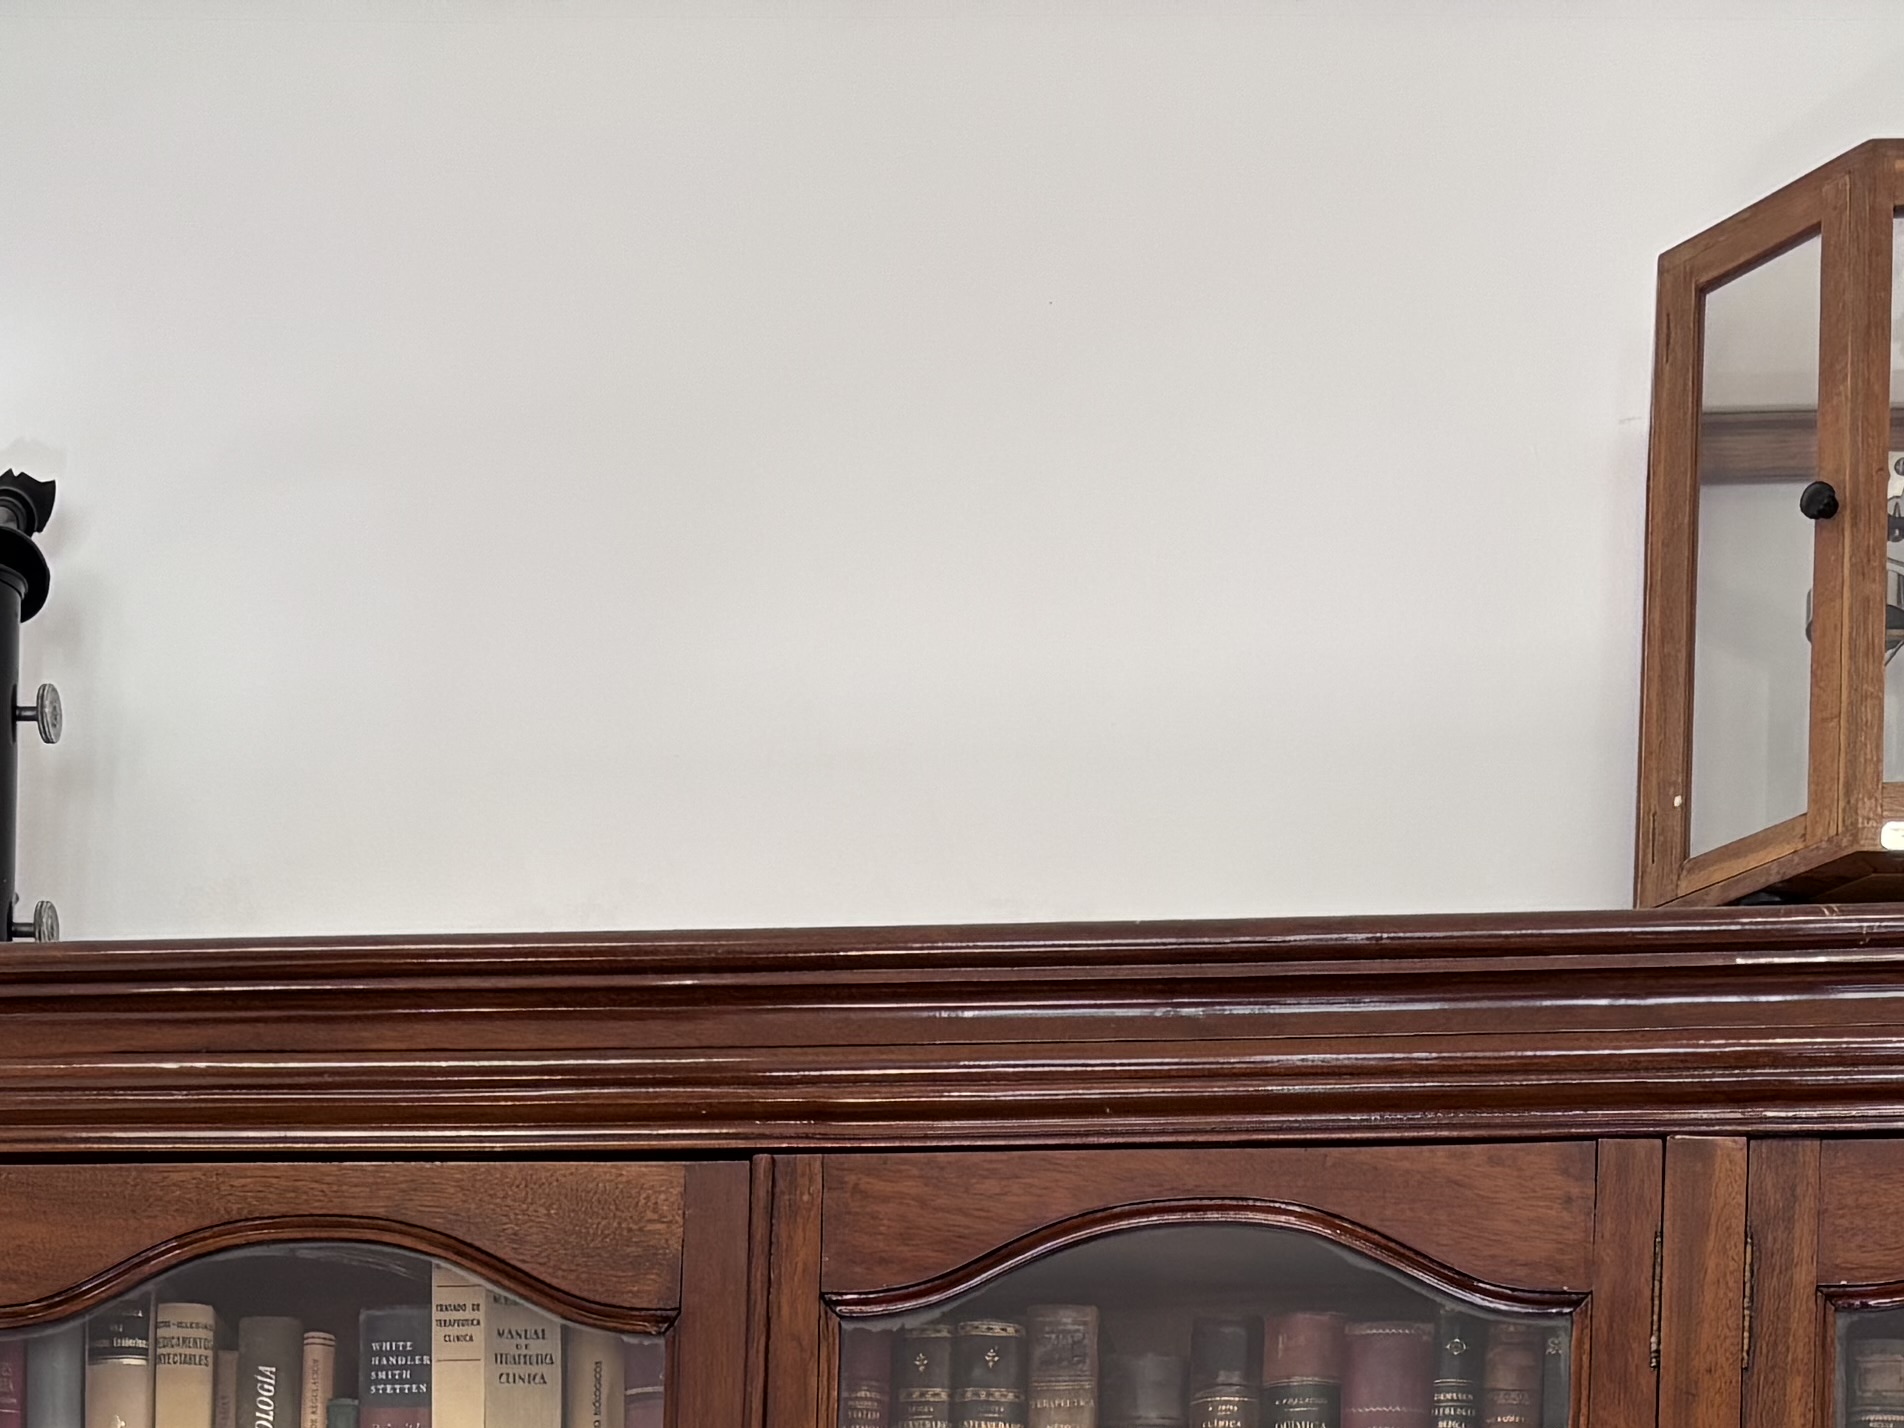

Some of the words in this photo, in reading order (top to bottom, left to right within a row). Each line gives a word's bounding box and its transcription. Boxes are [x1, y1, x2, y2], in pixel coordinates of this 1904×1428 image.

[496, 1328, 548, 1340] MANUAL
[371, 1342, 413, 1351] WHITE
[371, 1356, 431, 1365] HANDLER
[370, 1371, 411, 1379] SMITH
[498, 1372, 548, 1385] CLINICA
[370, 1384, 427, 1394] STETTEN
